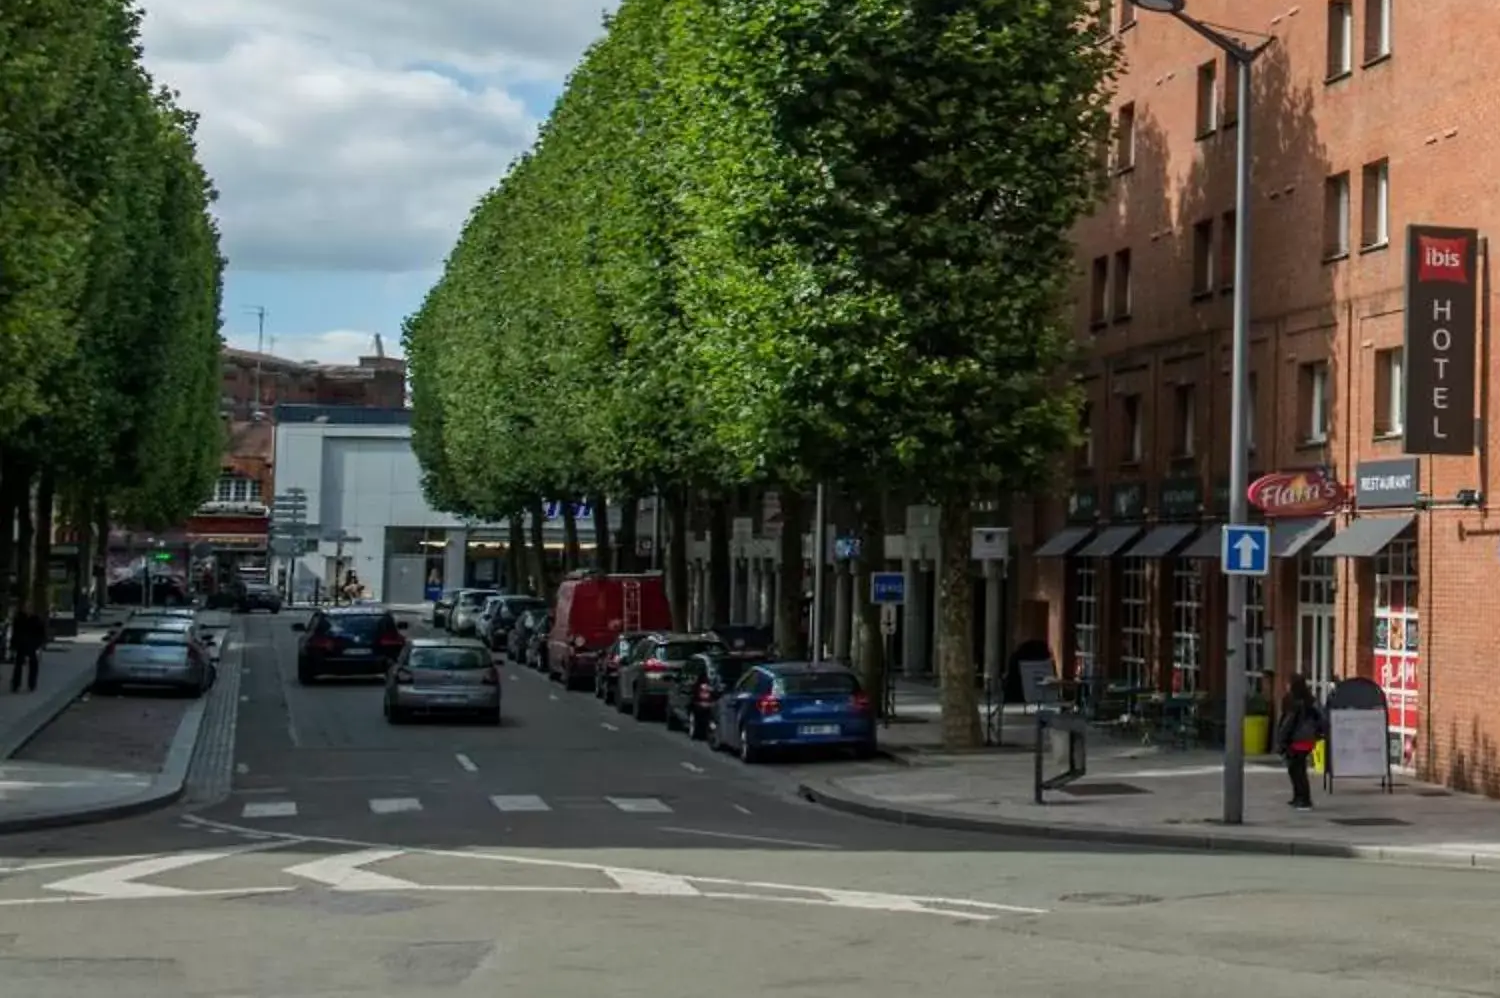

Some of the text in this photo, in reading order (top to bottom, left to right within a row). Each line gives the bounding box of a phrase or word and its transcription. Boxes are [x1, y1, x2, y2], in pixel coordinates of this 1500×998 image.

[1425, 246, 1460, 267] ibis
[1433, 299, 1452, 438] HOTEL
[1260, 478, 1337, 507] Flam's
[1360, 474, 1411, 490] RESTAURANT
